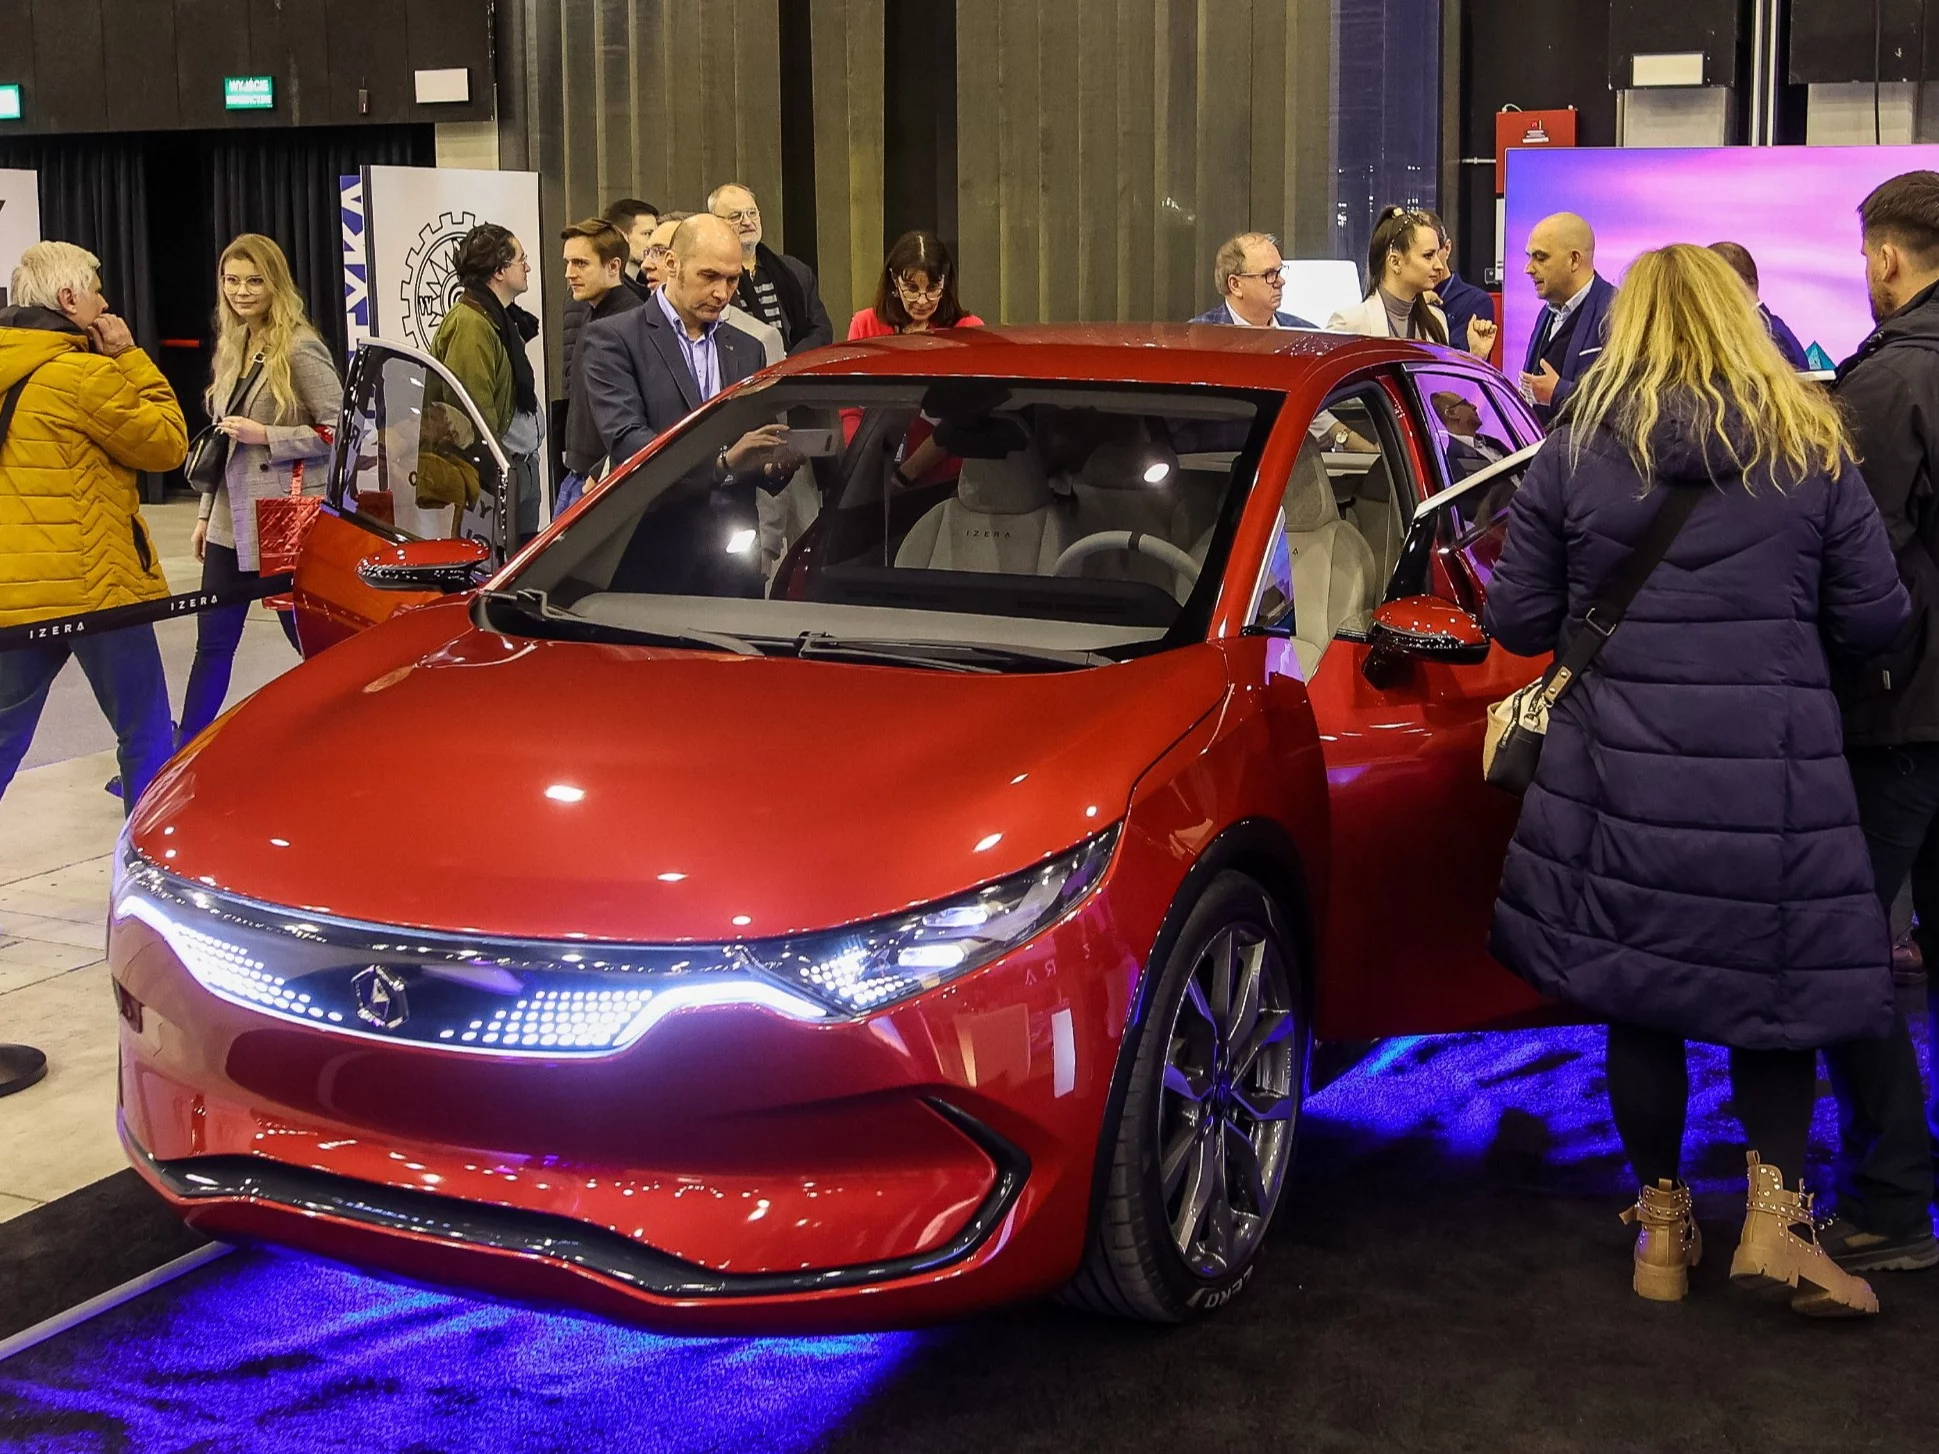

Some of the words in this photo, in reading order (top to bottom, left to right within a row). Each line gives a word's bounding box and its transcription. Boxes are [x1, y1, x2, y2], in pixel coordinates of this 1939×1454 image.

[965, 529, 1011, 539] IZERA
[170, 594, 218, 611] IZERA
[29, 621, 85, 640] IZERA
